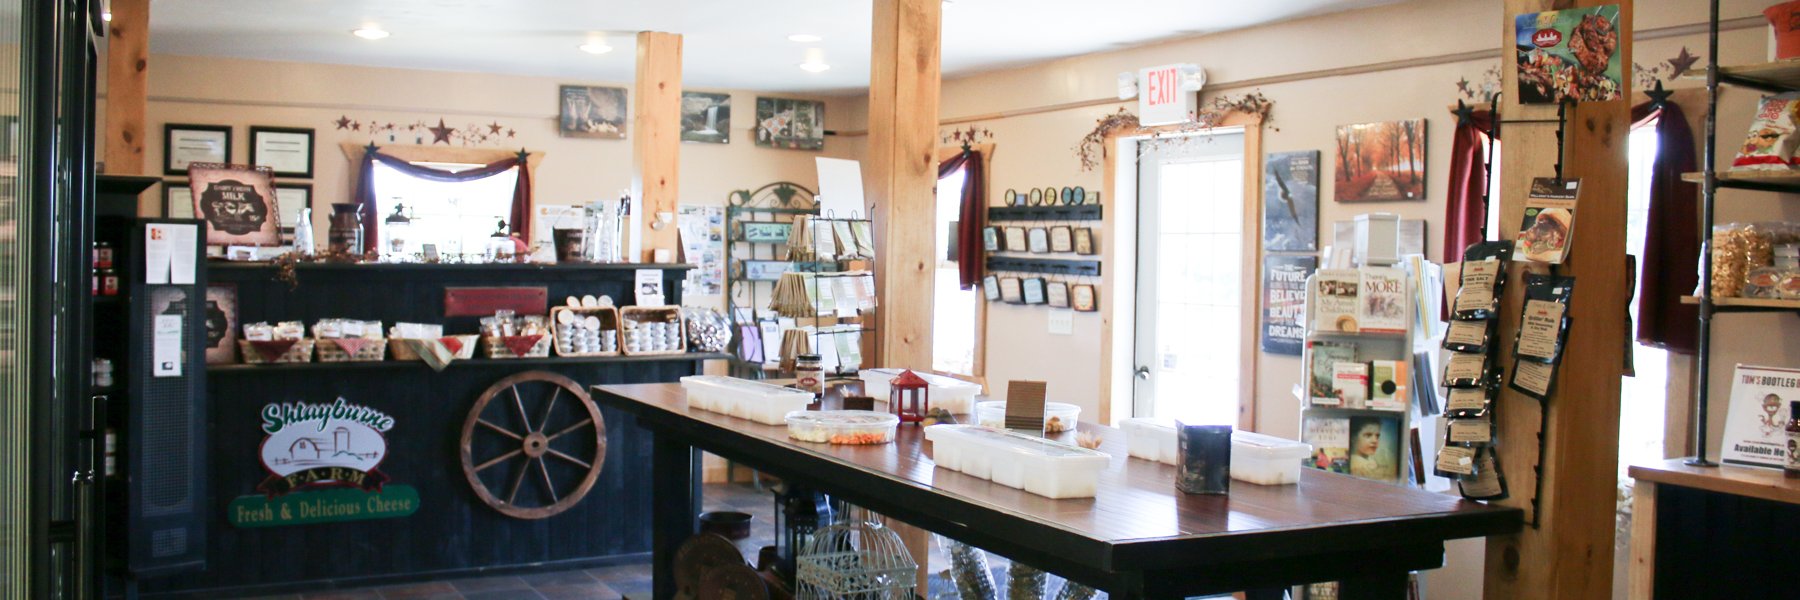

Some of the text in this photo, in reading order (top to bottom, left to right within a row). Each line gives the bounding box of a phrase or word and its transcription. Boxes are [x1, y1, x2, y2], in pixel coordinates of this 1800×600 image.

[1148, 68, 1176, 106] EXIT
[222, 191, 246, 201] MILK
[1271, 269, 1307, 282] FUTURE
[1365, 280, 1402, 294] MORE
[1269, 325, 1305, 338] DREAMS
[1741, 374, 1761, 385] TOM'S
[1761, 376, 1796, 388] BOOTLEG
[1734, 443, 1772, 456] Available
[1773, 447, 1785, 457] He
[237, 495, 411, 524] Fresh & Delicious Cheese
